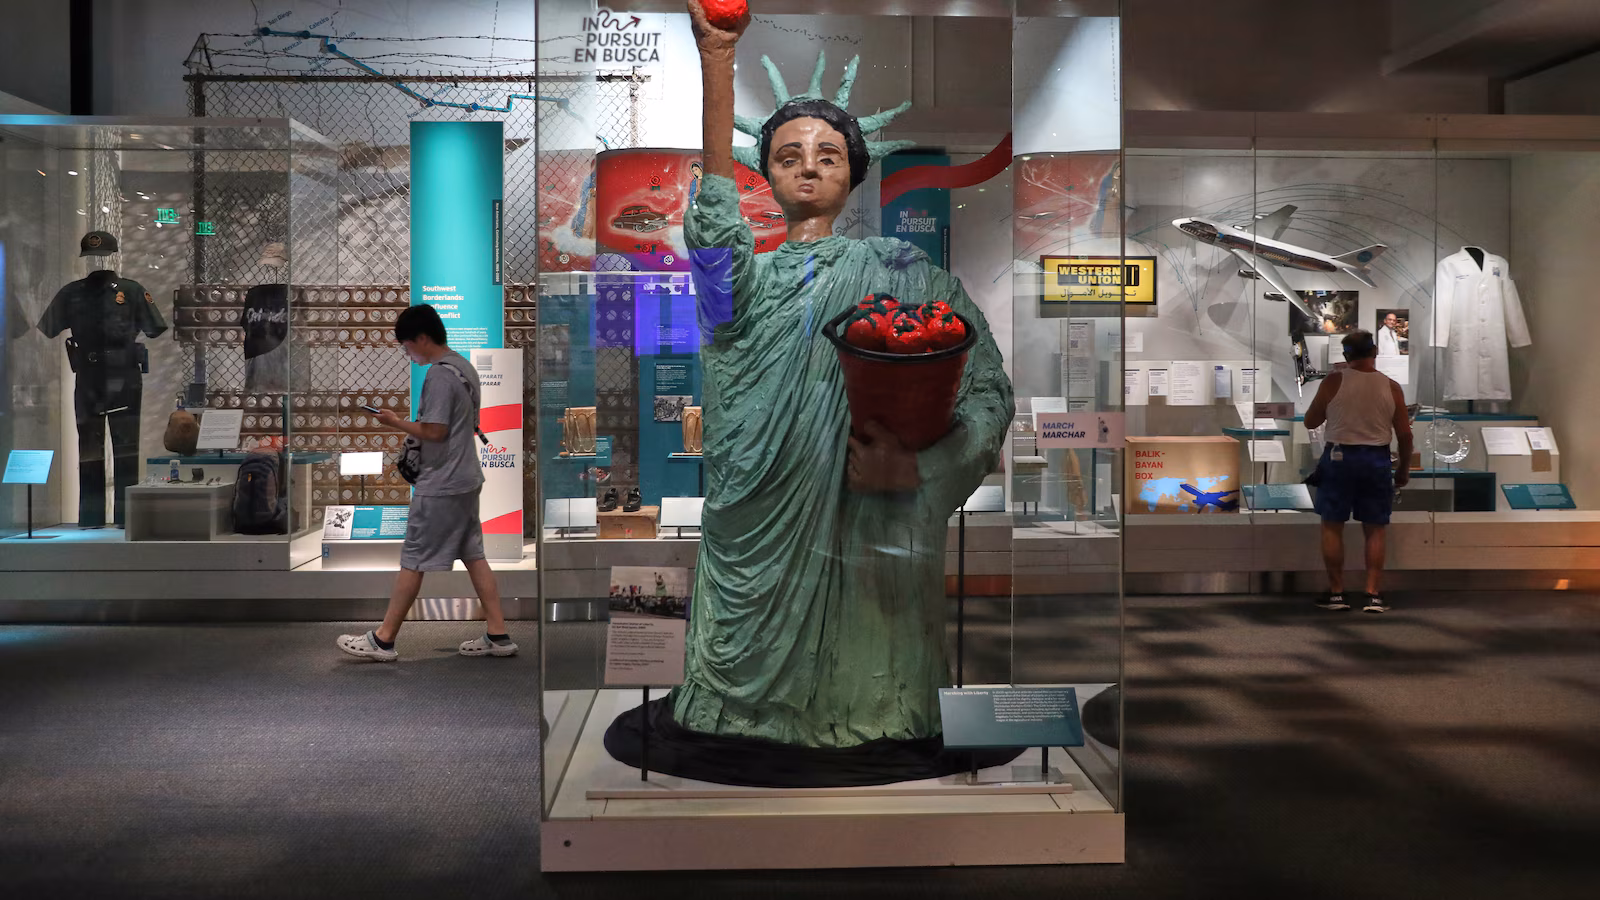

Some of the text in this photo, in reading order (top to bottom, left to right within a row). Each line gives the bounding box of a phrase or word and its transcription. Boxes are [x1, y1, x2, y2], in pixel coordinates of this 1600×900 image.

[582, 17, 600, 32] IN
[586, 32, 662, 47] PURSUIT
[574, 48, 660, 63] EN BUSCA
[901, 217, 937, 225] PURSUIT
[896, 225, 936, 233] EN BUSCA
[1059, 266, 1122, 275] WESTERN
[1078, 275, 1122, 285] UNION
[1042, 422, 1075, 430] MARCH
[1042, 431, 1086, 439] MARCHAR
[480, 447, 489, 455] IN
[489, 460, 516, 468] BUSCA
[1135, 461, 1164, 469] BAYAN
[1135, 472, 1153, 480] BOX
